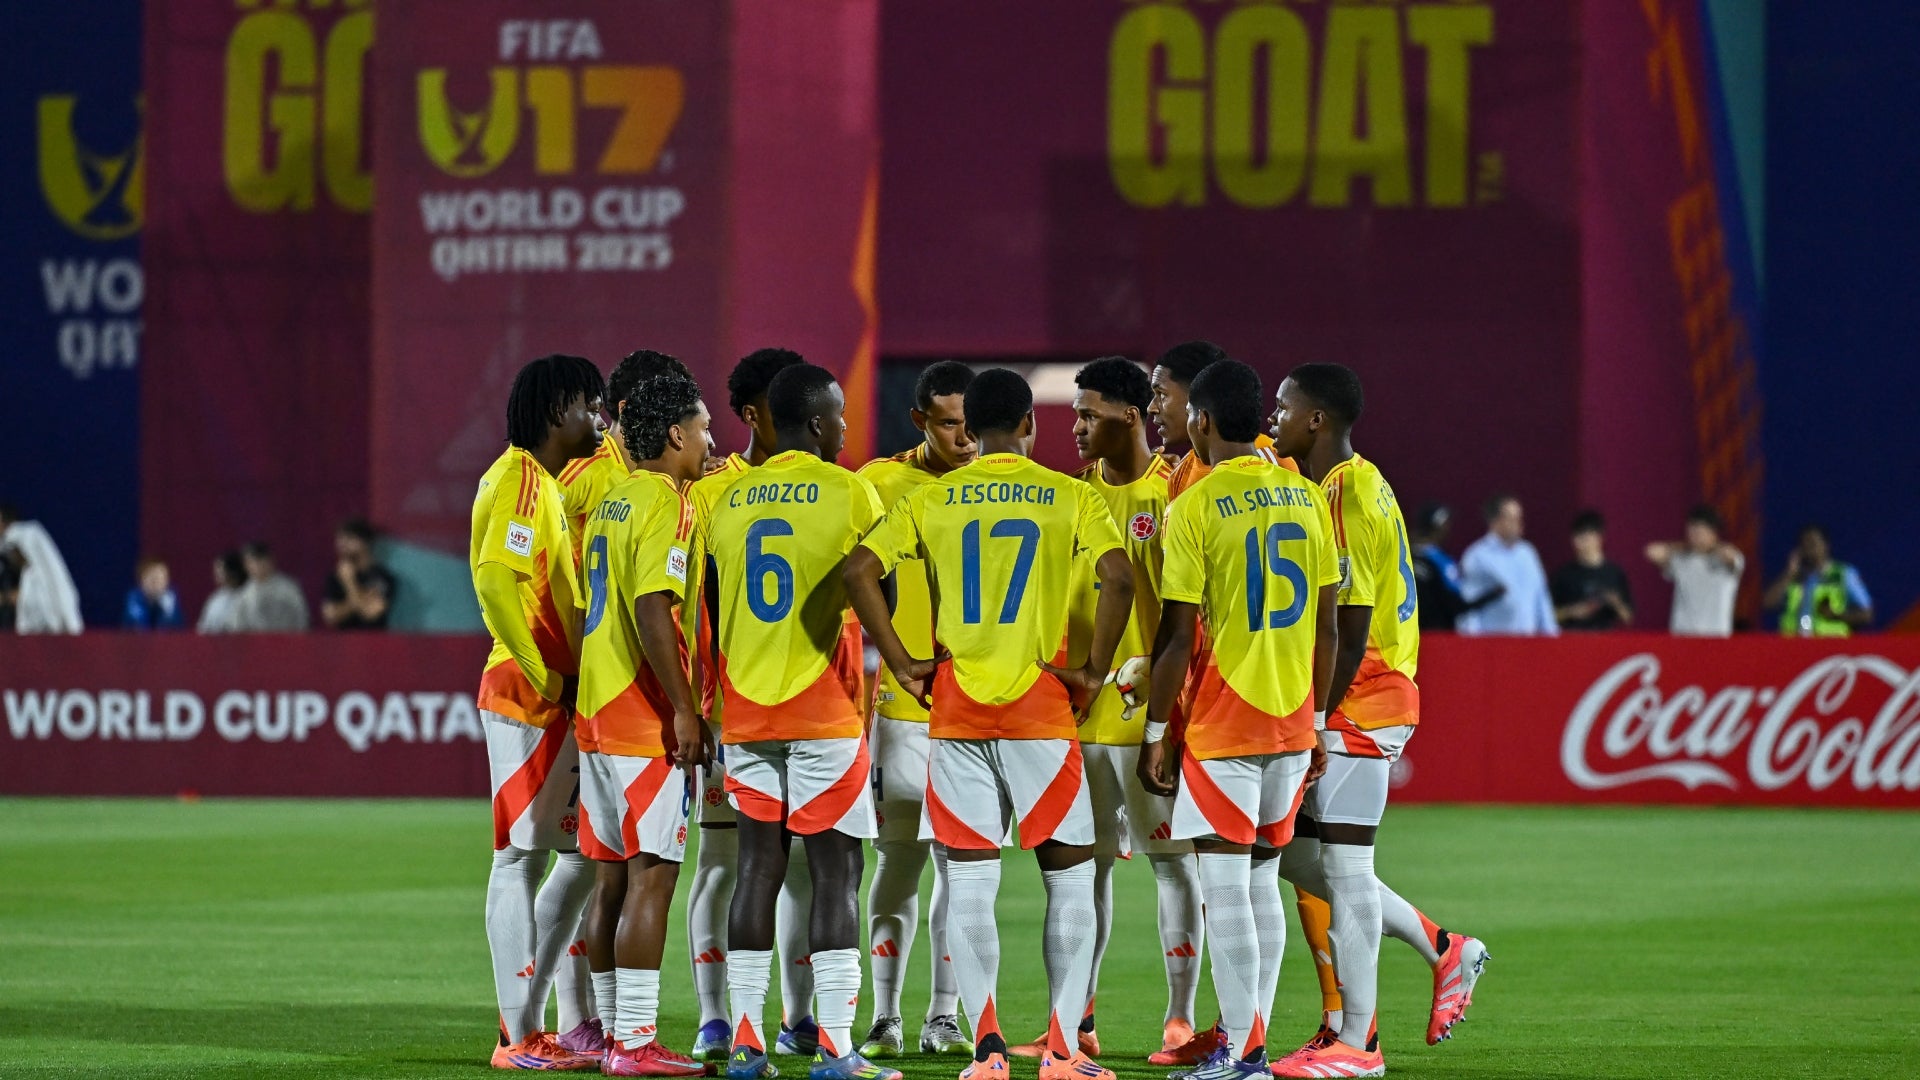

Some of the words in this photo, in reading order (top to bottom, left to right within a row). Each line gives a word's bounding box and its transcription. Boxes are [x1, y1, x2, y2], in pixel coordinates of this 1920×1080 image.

[501, 20, 602, 59] FIFA
[418, 66, 684, 178] U17
[1107, 4, 1495, 208] GOAT
[421, 189, 583, 232] WORLD
[593, 187, 684, 228] CUP
[432, 236, 568, 281] QATAR
[577, 233, 673, 269] 2025
[40, 258, 144, 314] WO
[730, 489, 741, 508] C.
[747, 483, 819, 505] OROZCO
[945, 487, 957, 505] J.
[961, 483, 1055, 505] ESCORCIA
[1216, 496, 1243, 518] M.
[1246, 486, 1312, 510] SOLARTE
[746, 518, 794, 623] 6
[962, 519, 1041, 624] 17
[1246, 522, 1307, 632] 15
[4, 690, 204, 740] WORLD
[214, 690, 327, 741] CUP
